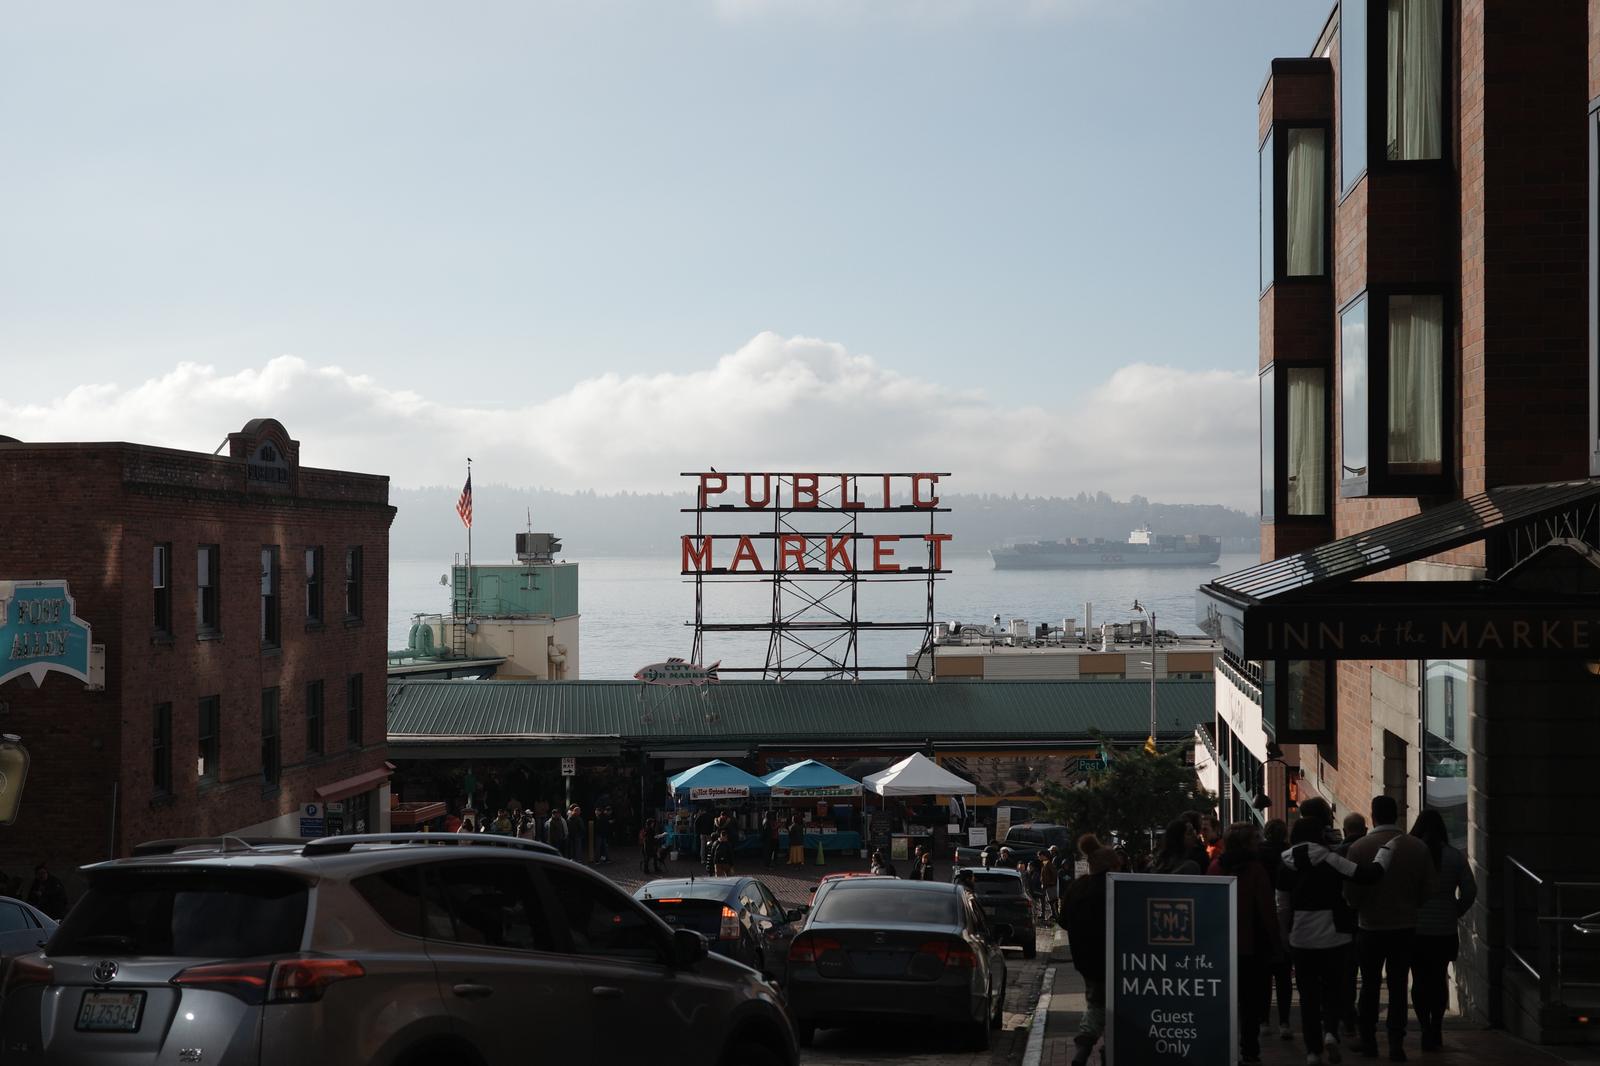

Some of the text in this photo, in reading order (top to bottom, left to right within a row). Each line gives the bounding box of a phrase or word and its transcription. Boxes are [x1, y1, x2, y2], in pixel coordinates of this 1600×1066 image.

[699, 473, 940, 510] PUBLIC
[682, 534, 953, 572] MARKET
[17, 599, 65, 625] POST
[8, 628, 70, 660] ALLEY
[1265, 620, 1345, 650] INN
[1359, 623, 1389, 645] at
[1393, 620, 1427, 644] the
[1122, 953, 1214, 972] INN at the
[1122, 977, 1222, 997] MARKET
[1151, 1008, 1195, 1024] Guest
[1148, 1023, 1198, 1040] Access
[1155, 1039, 1191, 1057] Only
